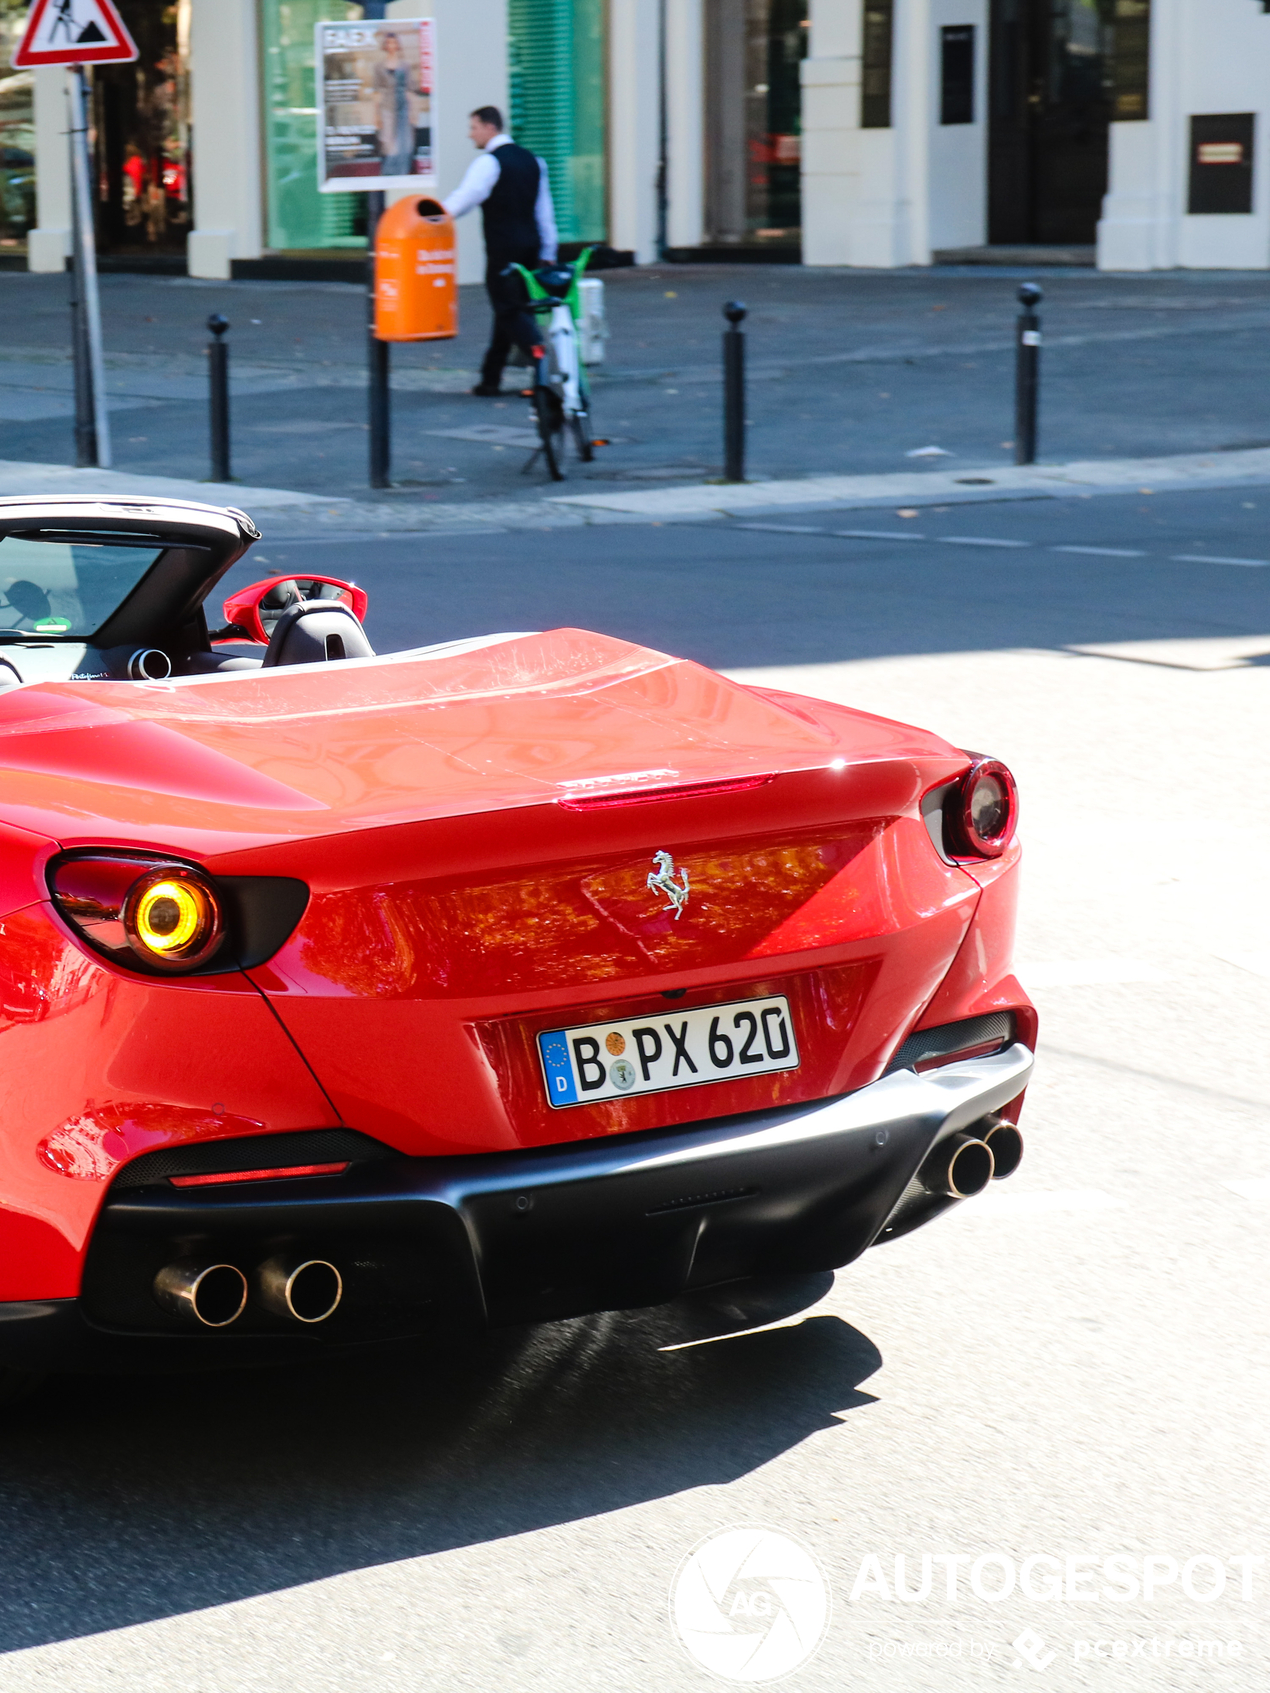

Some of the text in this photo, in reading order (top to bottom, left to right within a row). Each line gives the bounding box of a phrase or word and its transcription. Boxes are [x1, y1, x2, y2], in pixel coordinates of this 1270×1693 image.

[572, 1006, 790, 1092] B PX 620
[556, 1076, 568, 1092] D
